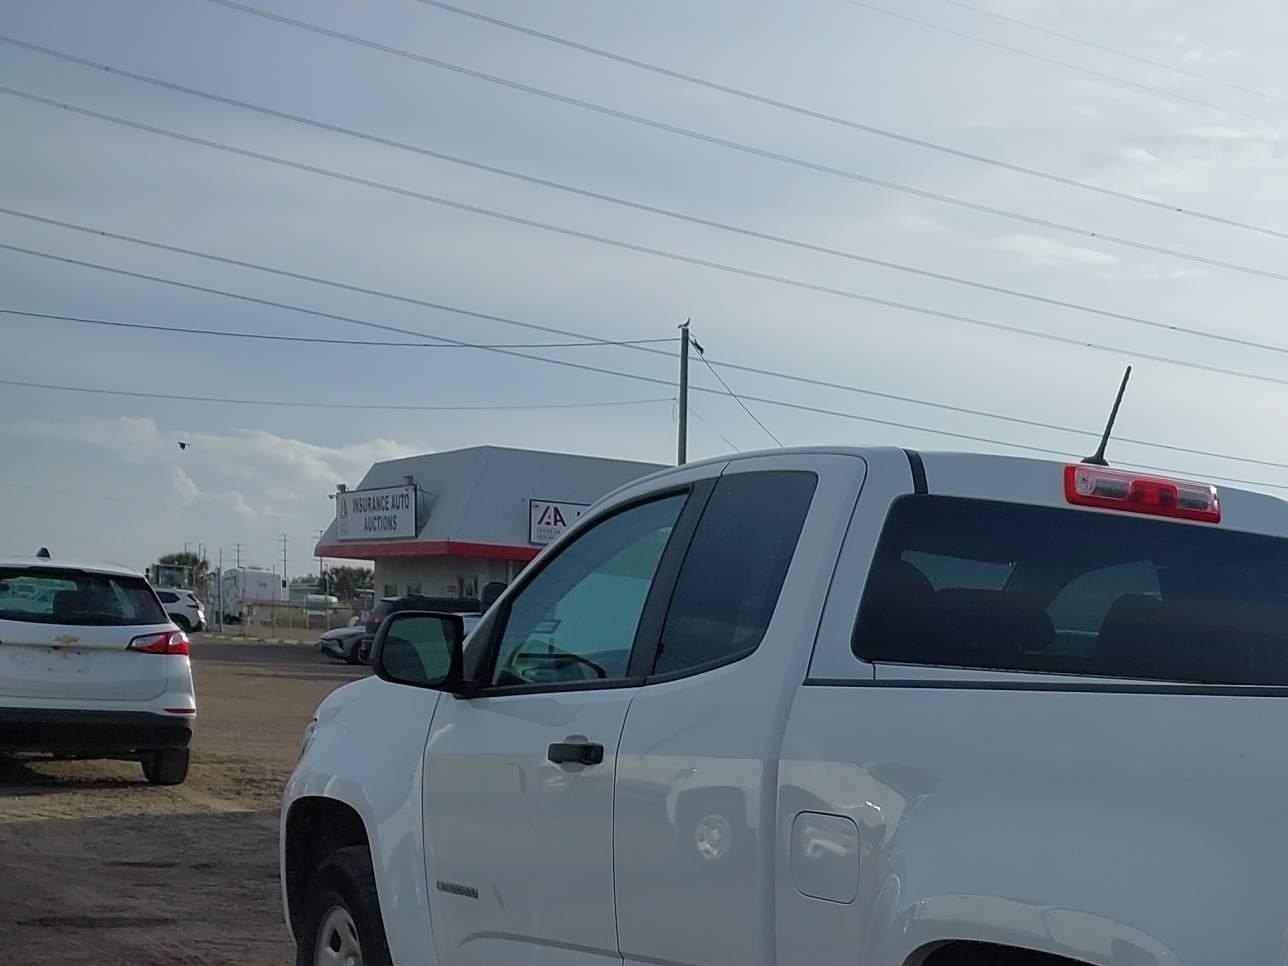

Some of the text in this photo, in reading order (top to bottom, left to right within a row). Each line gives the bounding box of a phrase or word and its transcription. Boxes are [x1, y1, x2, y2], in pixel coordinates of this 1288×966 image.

[352, 495, 390, 513] INSURANCE
[391, 493, 410, 511] AUTO
[363, 515, 397, 533] AUCTIONS
